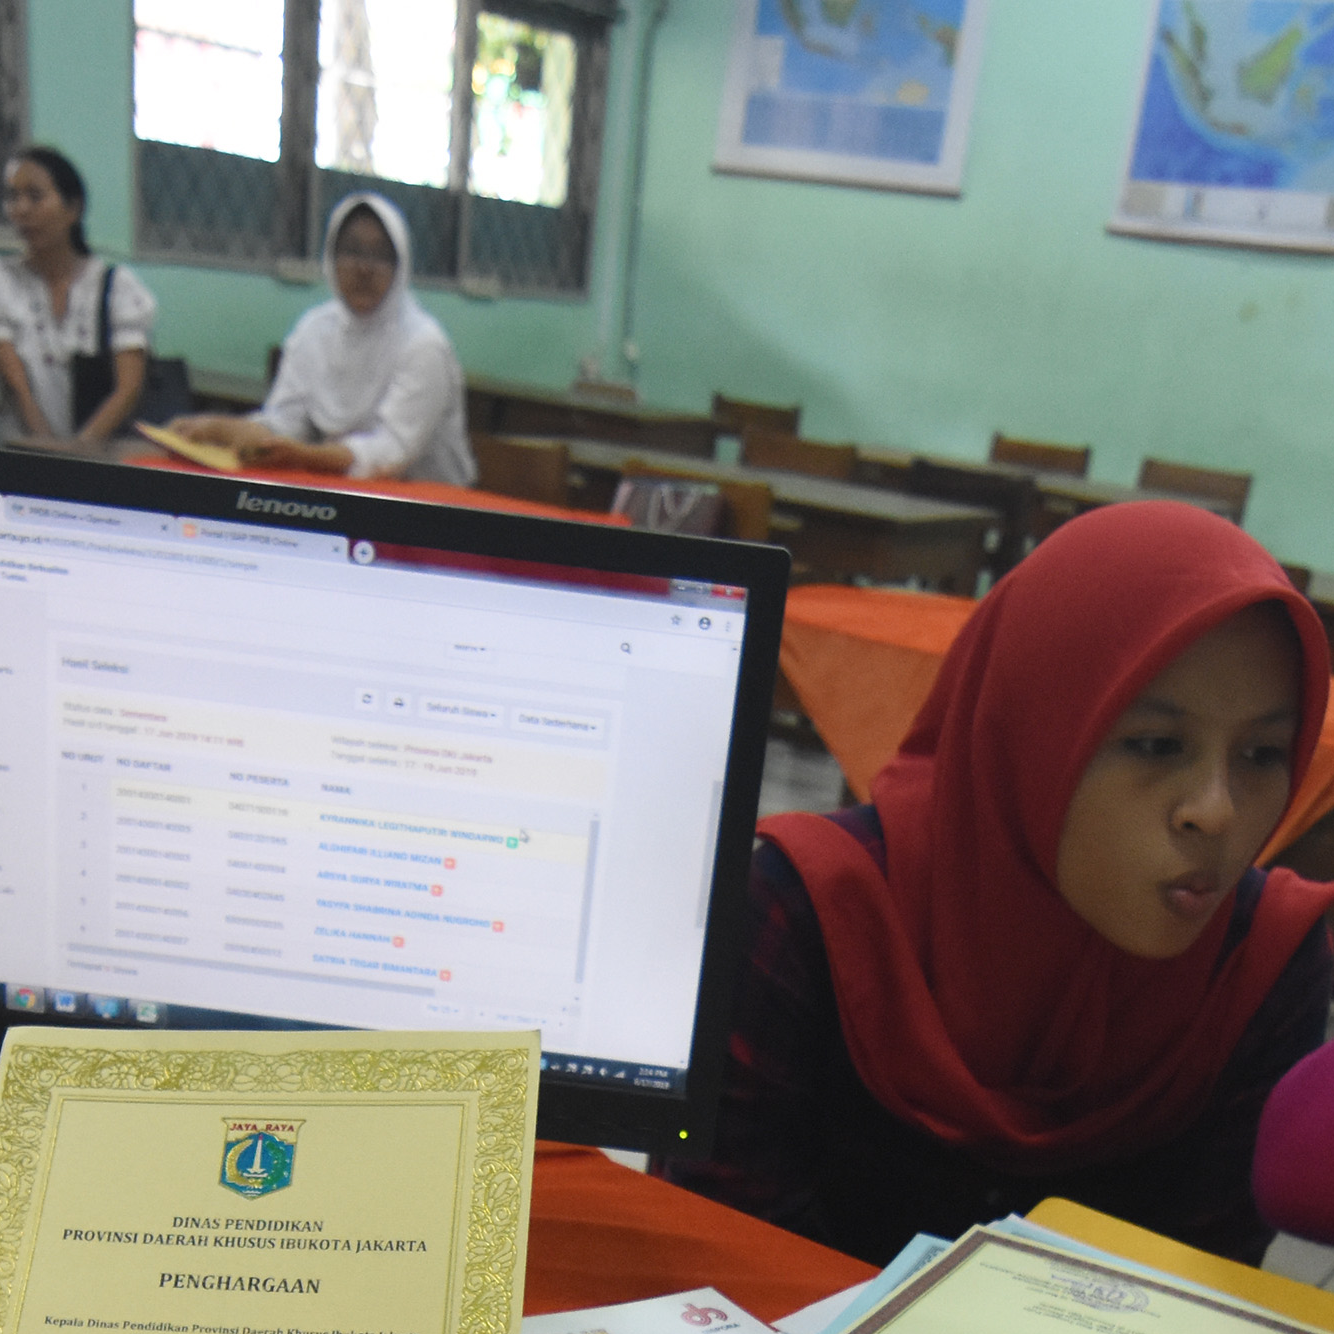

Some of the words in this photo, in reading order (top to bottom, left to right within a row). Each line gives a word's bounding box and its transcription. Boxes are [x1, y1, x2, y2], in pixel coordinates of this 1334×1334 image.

[236, 491, 337, 521] lenovo
[230, 1124, 258, 1132] JAYA
[265, 1124, 294, 1132] RAYA
[173, 1216, 220, 1231] DINAS
[225, 1219, 323, 1233] PENDIDIKAN
[63, 1229, 138, 1245] PROVINSI
[143, 1233, 208, 1248] DAERAH
[213, 1235, 276, 1250] KHUSUS
[280, 1237, 351, 1251] IBUKOTA
[355, 1239, 427, 1254] JAKARTA
[159, 1273, 320, 1294] PENGHARGAAN
[44, 1316, 84, 1330] Kepala
[87, 1318, 119, 1331] Dinas
[123, 1320, 188, 1333] Pendidikan
